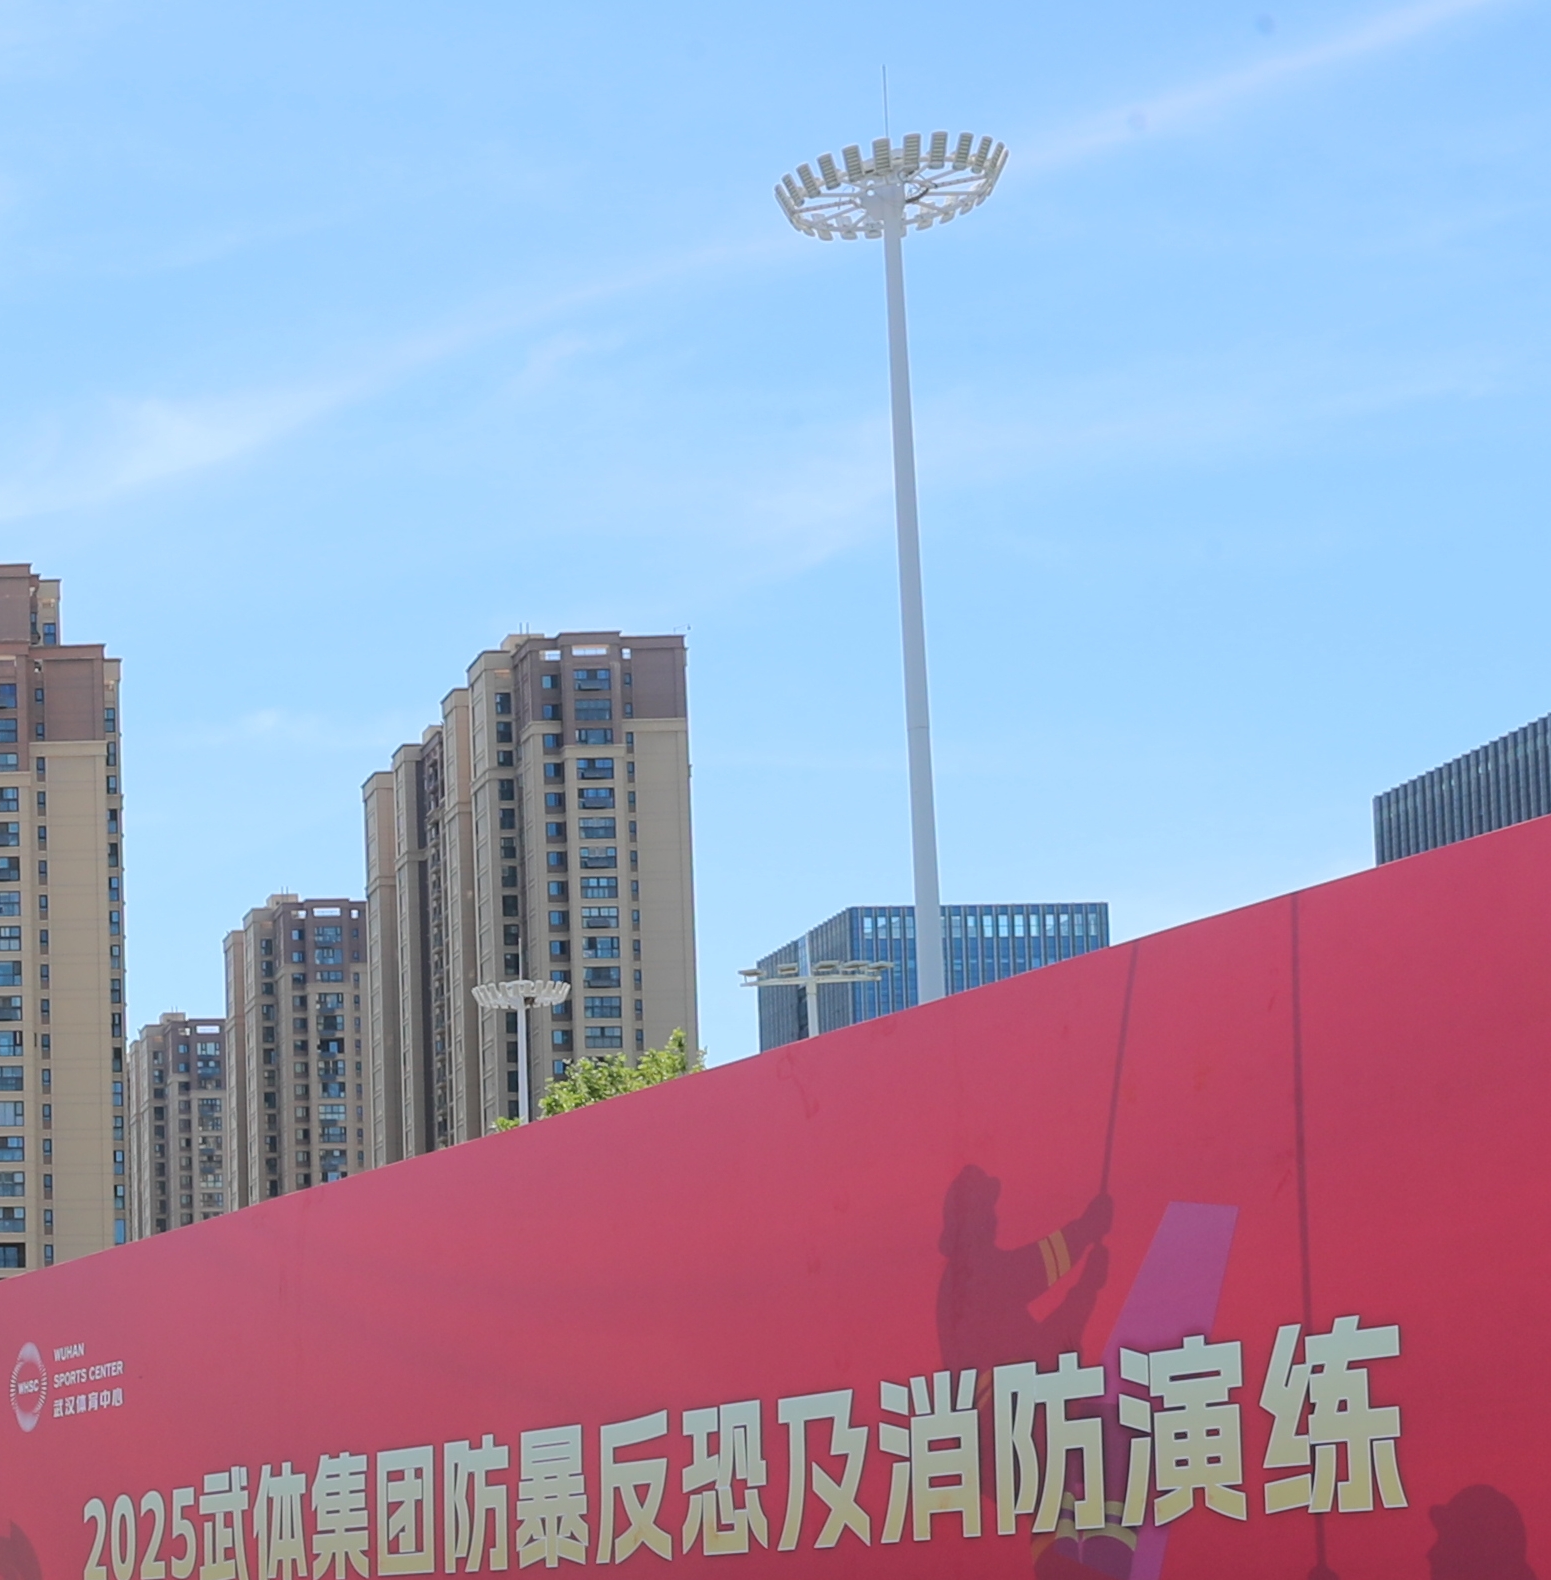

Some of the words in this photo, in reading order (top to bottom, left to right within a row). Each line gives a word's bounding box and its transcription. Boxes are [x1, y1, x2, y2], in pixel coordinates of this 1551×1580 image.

[53, 1343, 85, 1362] WUHAN
[53, 1368, 88, 1389] SPORTS
[89, 1360, 125, 1381] CENTER
[17, 1379, 40, 1395] WHSC
[53, 1387, 124, 1418] 武汉体育中心
